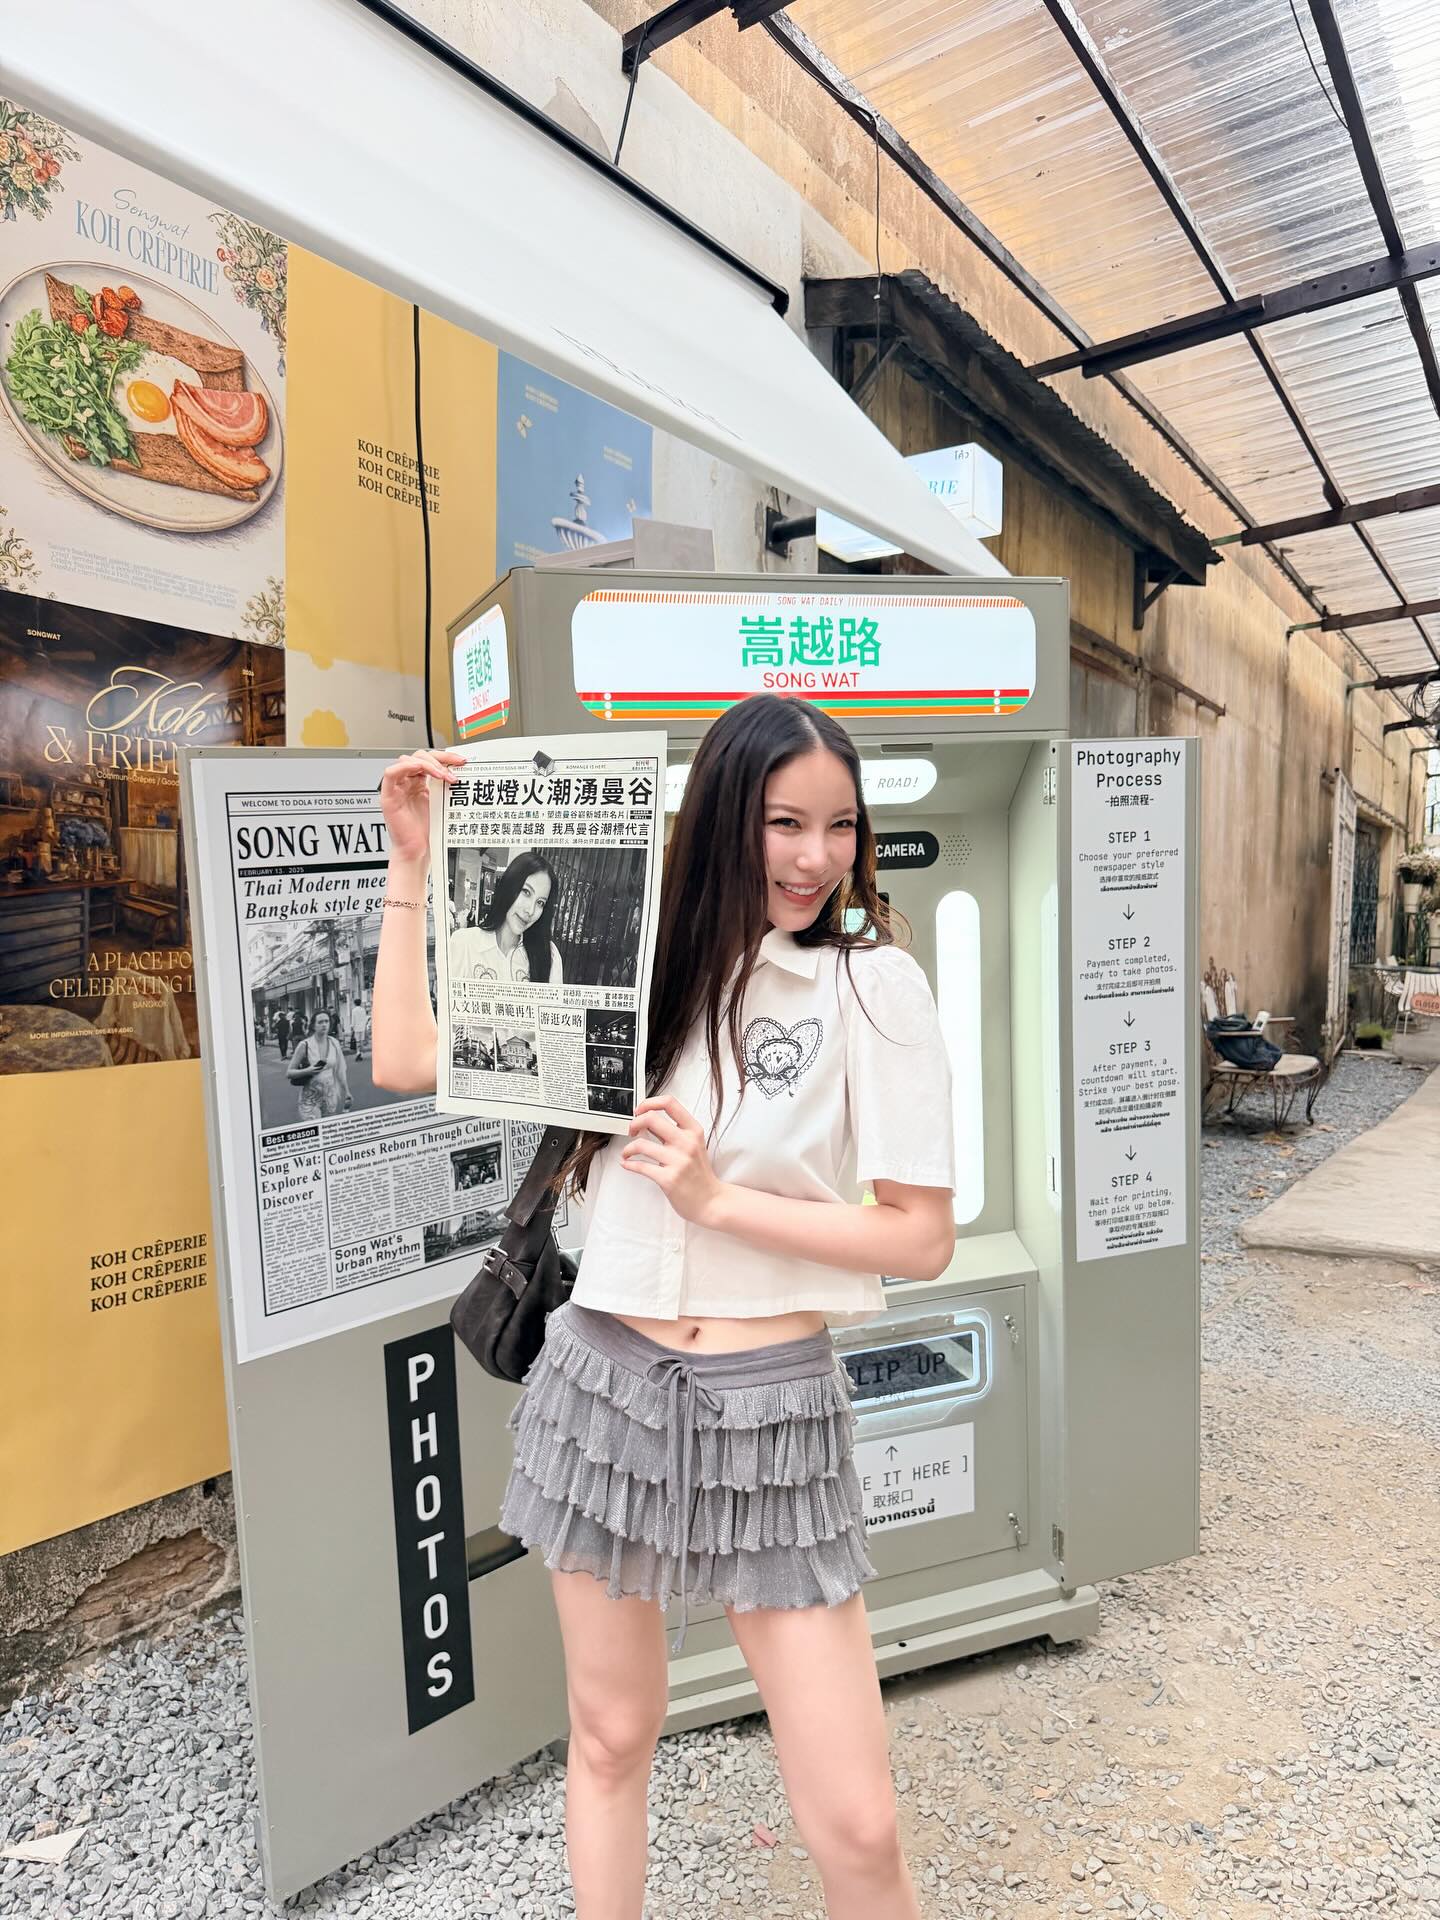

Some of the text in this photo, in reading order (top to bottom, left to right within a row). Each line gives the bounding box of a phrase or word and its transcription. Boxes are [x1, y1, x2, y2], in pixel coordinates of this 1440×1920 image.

[114, 189, 190, 240] Songwat
[76, 200, 220, 296] KOH CRÊPERIE
[358, 438, 382, 458] KOH
[358, 456, 382, 476] KOH
[358, 475, 440, 514] KOH CRÊPEIE
[777, 596, 844, 606] SONG WAT DAILY
[27, 628, 61, 640] SONGWAT
[739, 615, 882, 667] 嵩越路
[763, 672, 860, 688] SONG WAT
[86, 666, 218, 736] Koh
[44, 726, 73, 764] &
[1077, 748, 1180, 767] Photography
[878, 776, 918, 788] ROAD!
[1096, 774, 1162, 788] Process
[449, 776, 652, 807] 嵩越燈火潮湧曼谷
[242, 800, 278, 808] WELCOME
[237, 822, 386, 860] SONG WAT
[1108, 830, 1151, 844] STEP 1
[875, 842, 926, 858] CAMERA
[1079, 848, 1178, 862] Choose your preferred
[1094, 860, 1164, 872] newspaper style
[244, 876, 386, 897] Thai Modern mee
[245, 899, 318, 920] Bangkok
[325, 896, 360, 916] style
[1108, 936, 1150, 950] STEP 2
[88, 952, 193, 972] A PLACE FO
[1086, 959, 1120, 968] Payment
[1080, 965, 1177, 980] ready to take photos.
[50, 975, 183, 999] CELEBRATING
[30, 1032, 48, 1040] MORE
[1110, 1040, 1151, 1055] STEP 3
[1081, 1068, 1178, 1084] countdown will start.
[1092, 1064, 1116, 1072] After
[1079, 1078, 1180, 1096] Strike your best pose.
[266, 1128, 316, 1145] Best season
[328, 1148, 376, 1166] Coolness
[380, 1138, 416, 1154] Reborn
[420, 1126, 462, 1144] Through
[466, 1120, 500, 1134] Culture
[260, 1154, 320, 1177] Song Wat:
[262, 1169, 322, 1194] Explore &
[1112, 1172, 1152, 1188] STEP 4
[262, 1190, 314, 1210] Discover
[1088, 1198, 1174, 1218] then pick up below.
[1090, 1196, 1109, 1206] Wait
[1114, 1194, 1128, 1202] for
[90, 1233, 208, 1270] KOH CRÊPERIE
[335, 1234, 403, 1260] Song Wat's
[336, 1256, 372, 1273] Urban
[376, 1242, 420, 1262] Rhythm
[90, 1254, 208, 1291] KOH CRÊPERIE
[90, 1272, 208, 1312] KOH CRÊPERIE
[918, 1352, 946, 1376] UP
[884, 1470, 902, 1488] IT
[912, 1460, 951, 1480] HERE
[873, 1489, 912, 1508] 取报口
[407, 1352, 454, 1699] PHOTOS
